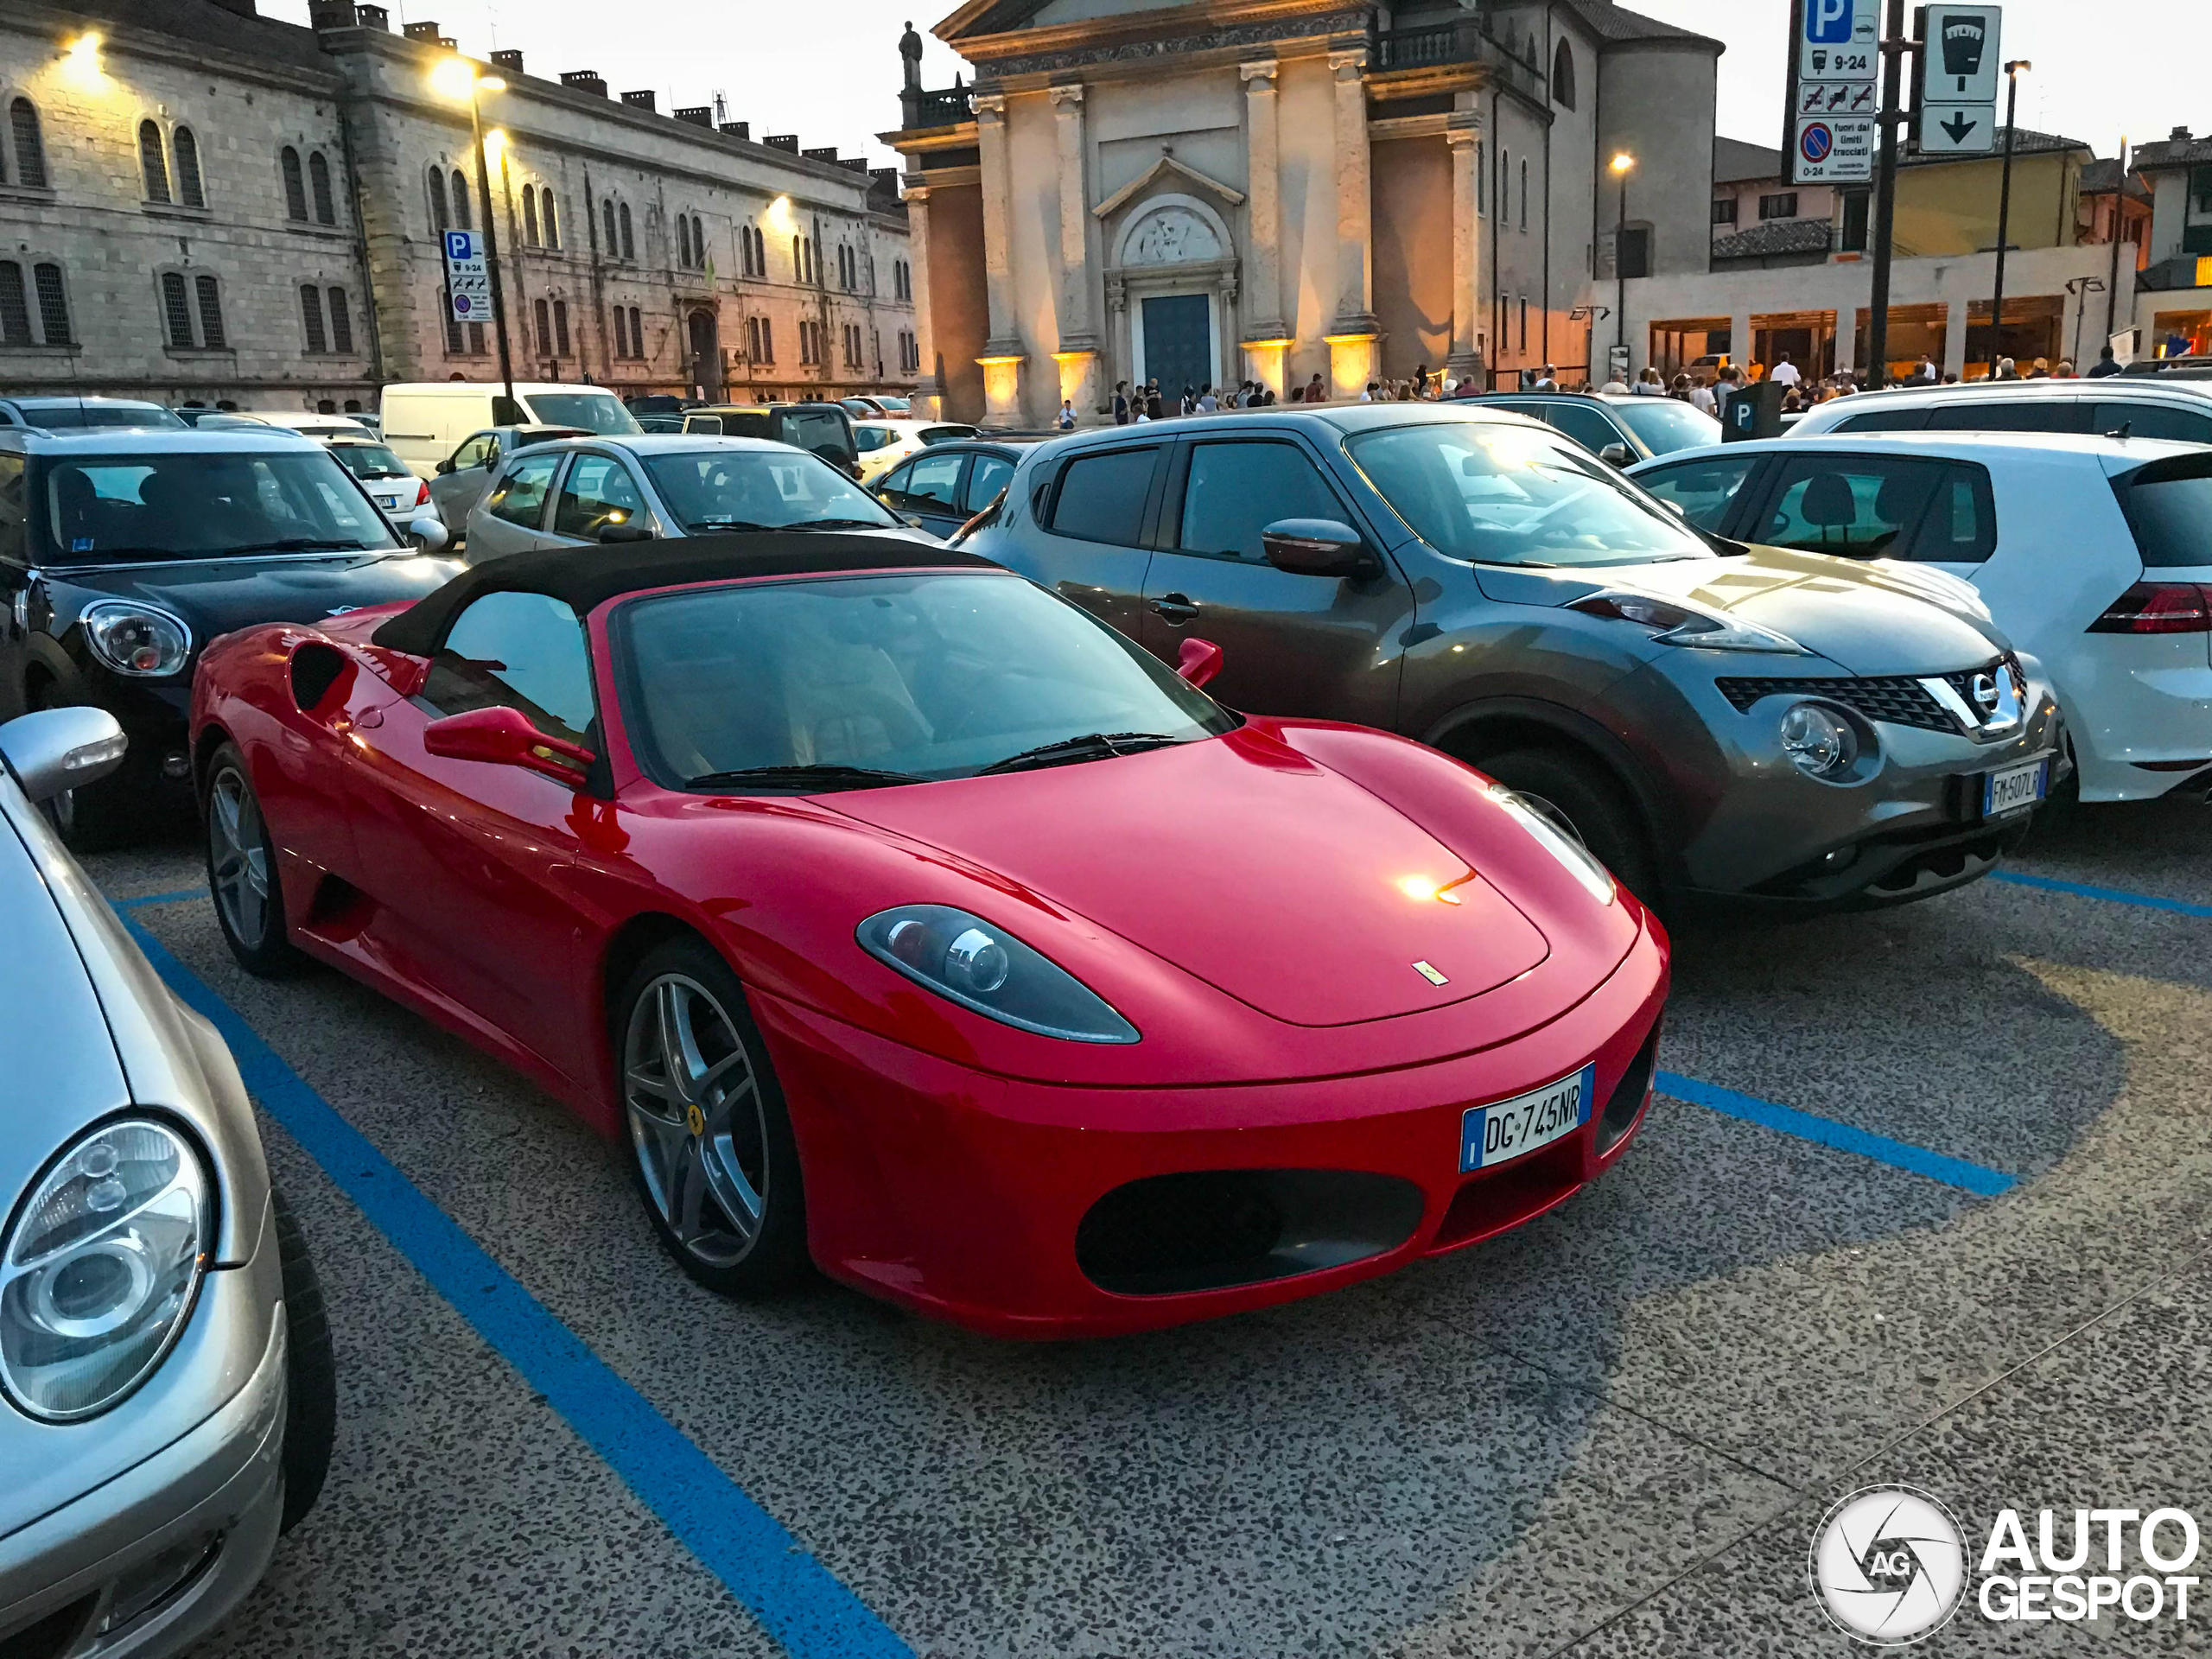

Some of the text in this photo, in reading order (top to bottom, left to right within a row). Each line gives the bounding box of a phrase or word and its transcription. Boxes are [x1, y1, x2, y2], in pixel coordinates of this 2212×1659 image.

[1815, 0, 1844, 37] P
[1834, 55, 1867, 70] 9-24
[1834, 123, 1854, 132] fuori
[1840, 135, 1862, 144] limiti
[1833, 147, 1868, 156] tracciati
[1803, 167, 1823, 176] 0-24
[451, 234, 467, 257] P
[465, 264, 482, 272] 9-24
[1738, 404, 1751, 426] P
